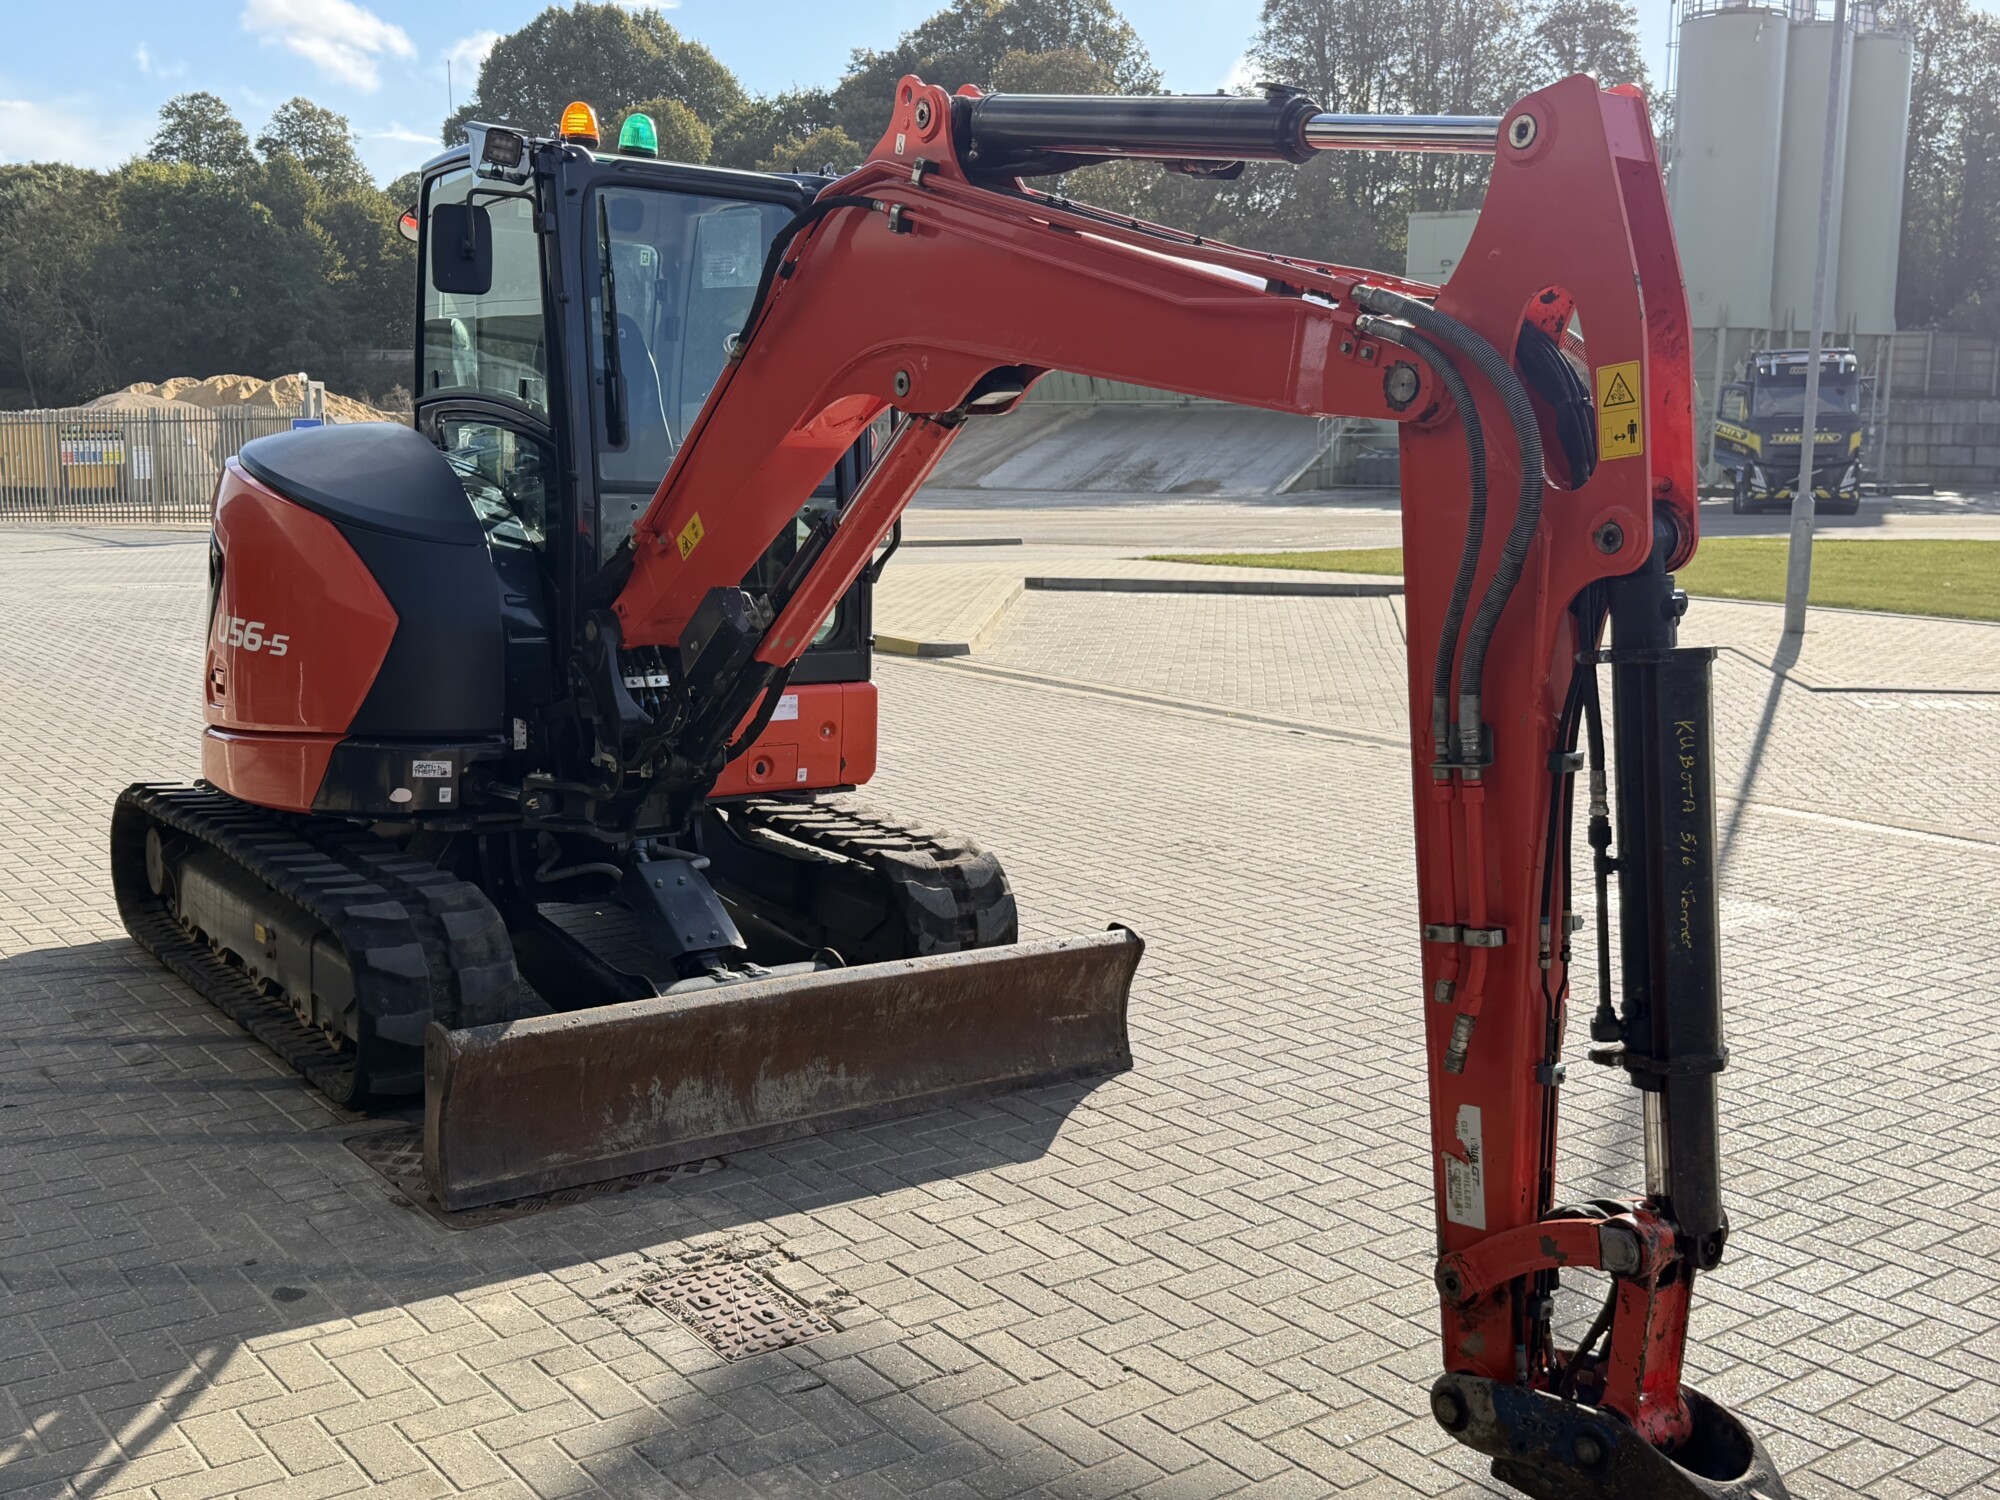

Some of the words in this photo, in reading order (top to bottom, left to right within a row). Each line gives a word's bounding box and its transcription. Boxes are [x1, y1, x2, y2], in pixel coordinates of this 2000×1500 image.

[217, 613, 290, 656] U56-5
[1674, 720, 1696, 812] KUBOTA
[1453, 1167, 1464, 1217] COUPLER
[1463, 1170, 1472, 1210] MILLER
[1471, 1165, 1480, 1187] GT
